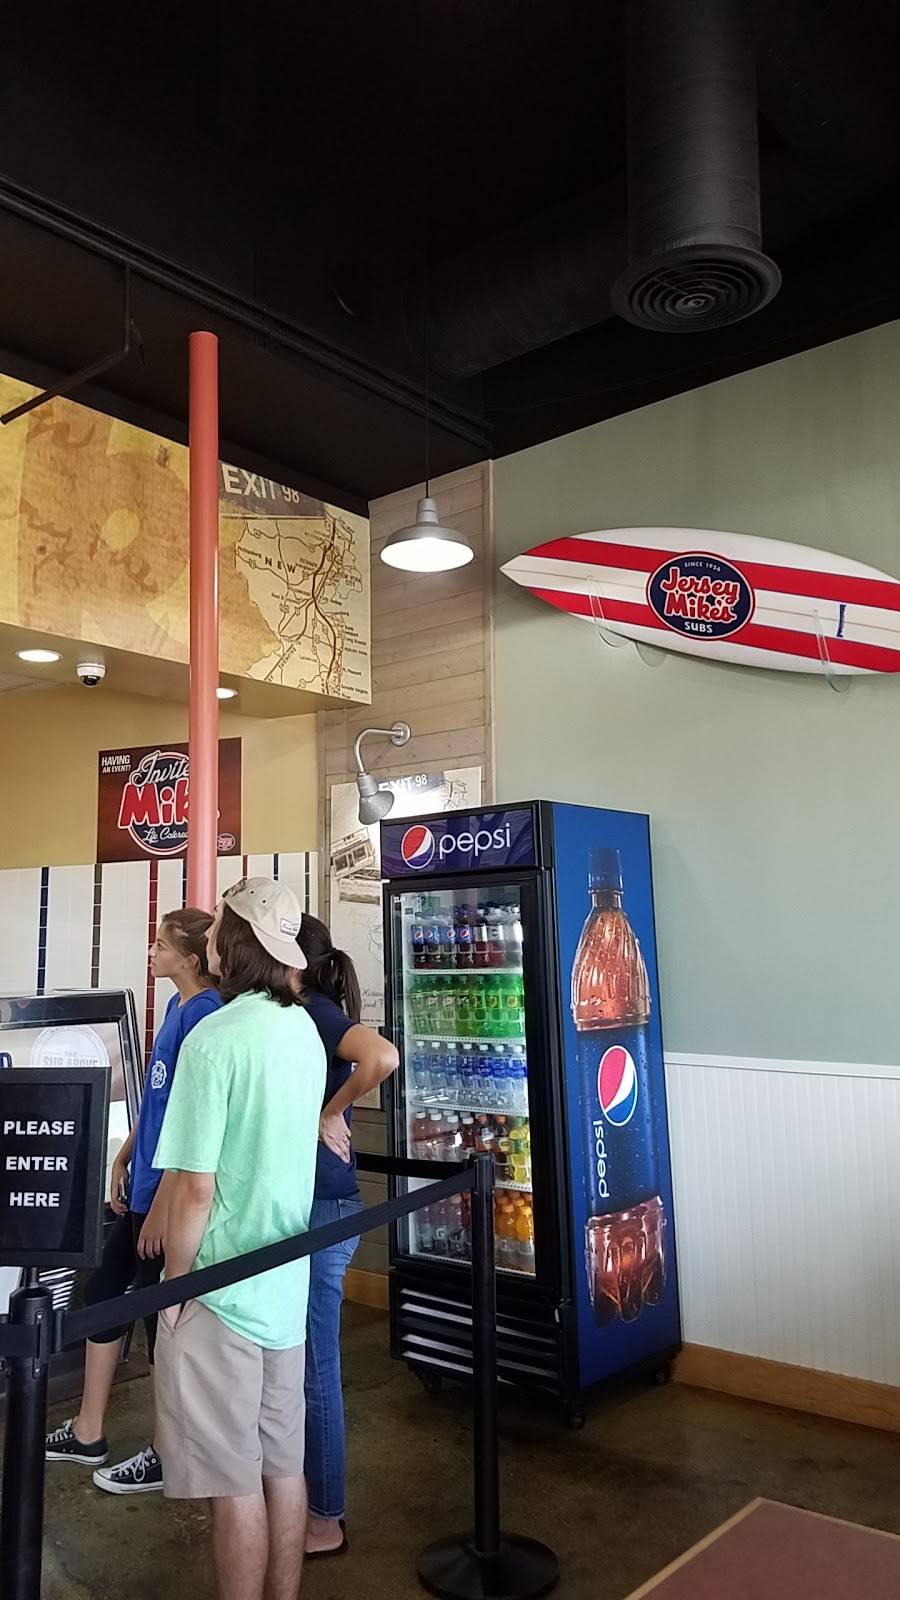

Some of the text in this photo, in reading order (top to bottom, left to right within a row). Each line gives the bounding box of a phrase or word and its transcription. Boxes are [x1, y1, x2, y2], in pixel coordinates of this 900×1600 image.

[221, 463, 300, 504] EXIT 98
[660, 566, 740, 607] Jersey
[664, 591, 738, 624] Mike's
[684, 621, 713, 633] SUBS
[101, 755, 131, 767] HAVING
[112, 764, 131, 773] EVENT?
[379, 774, 428, 792] EXIT 98
[118, 778, 190, 829] Mik
[439, 822, 511, 860] pepsi
[3, 1120, 75, 1136] PLEASE
[5, 1156, 69, 1171] ENTER
[593, 1120, 610, 1199] pepsi
[9, 1192, 61, 1208] HERE
